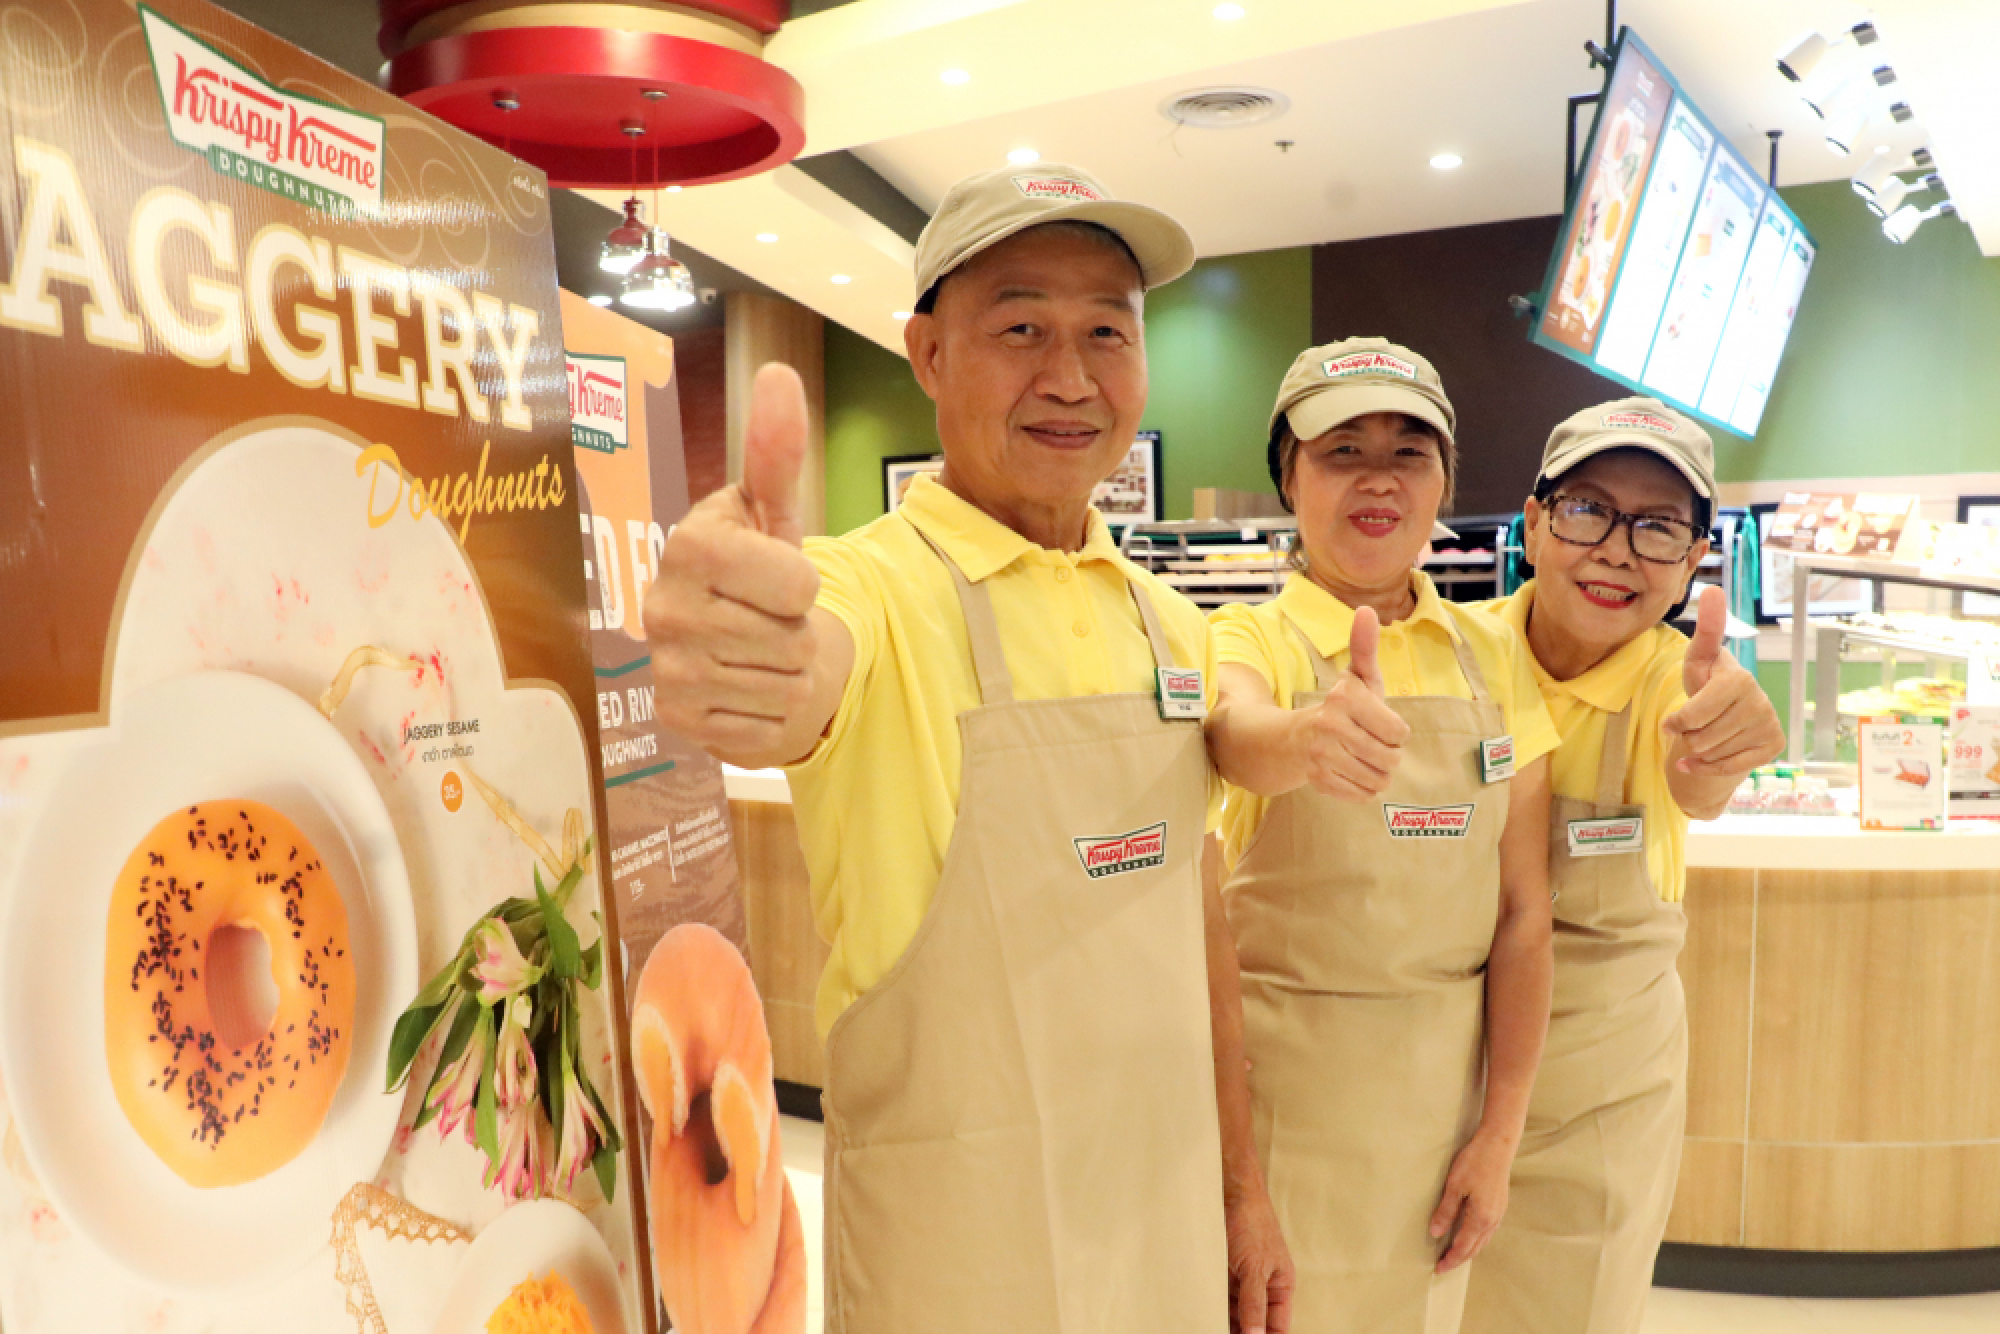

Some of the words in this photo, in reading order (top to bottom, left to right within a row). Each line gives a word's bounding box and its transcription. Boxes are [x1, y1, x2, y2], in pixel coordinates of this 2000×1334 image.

[173, 52, 285, 164] Krispy
[287, 103, 377, 189] Kreme
[1330, 353, 1373, 373] Krispy
[1374, 353, 1413, 375] Kreme
[577, 365, 624, 423] Kreme
[355, 439, 567, 546] Doughnuts
[403, 723, 444, 747] JAGGERY
[446, 717, 480, 736] SESAME
[1954, 745, 1983, 759] 999
[1391, 810, 1428, 830] Krispy
[1429, 810, 1467, 827] Kreme
[1086, 840, 1123, 867] Krispy
[1123, 831, 1162, 858] Kreme
